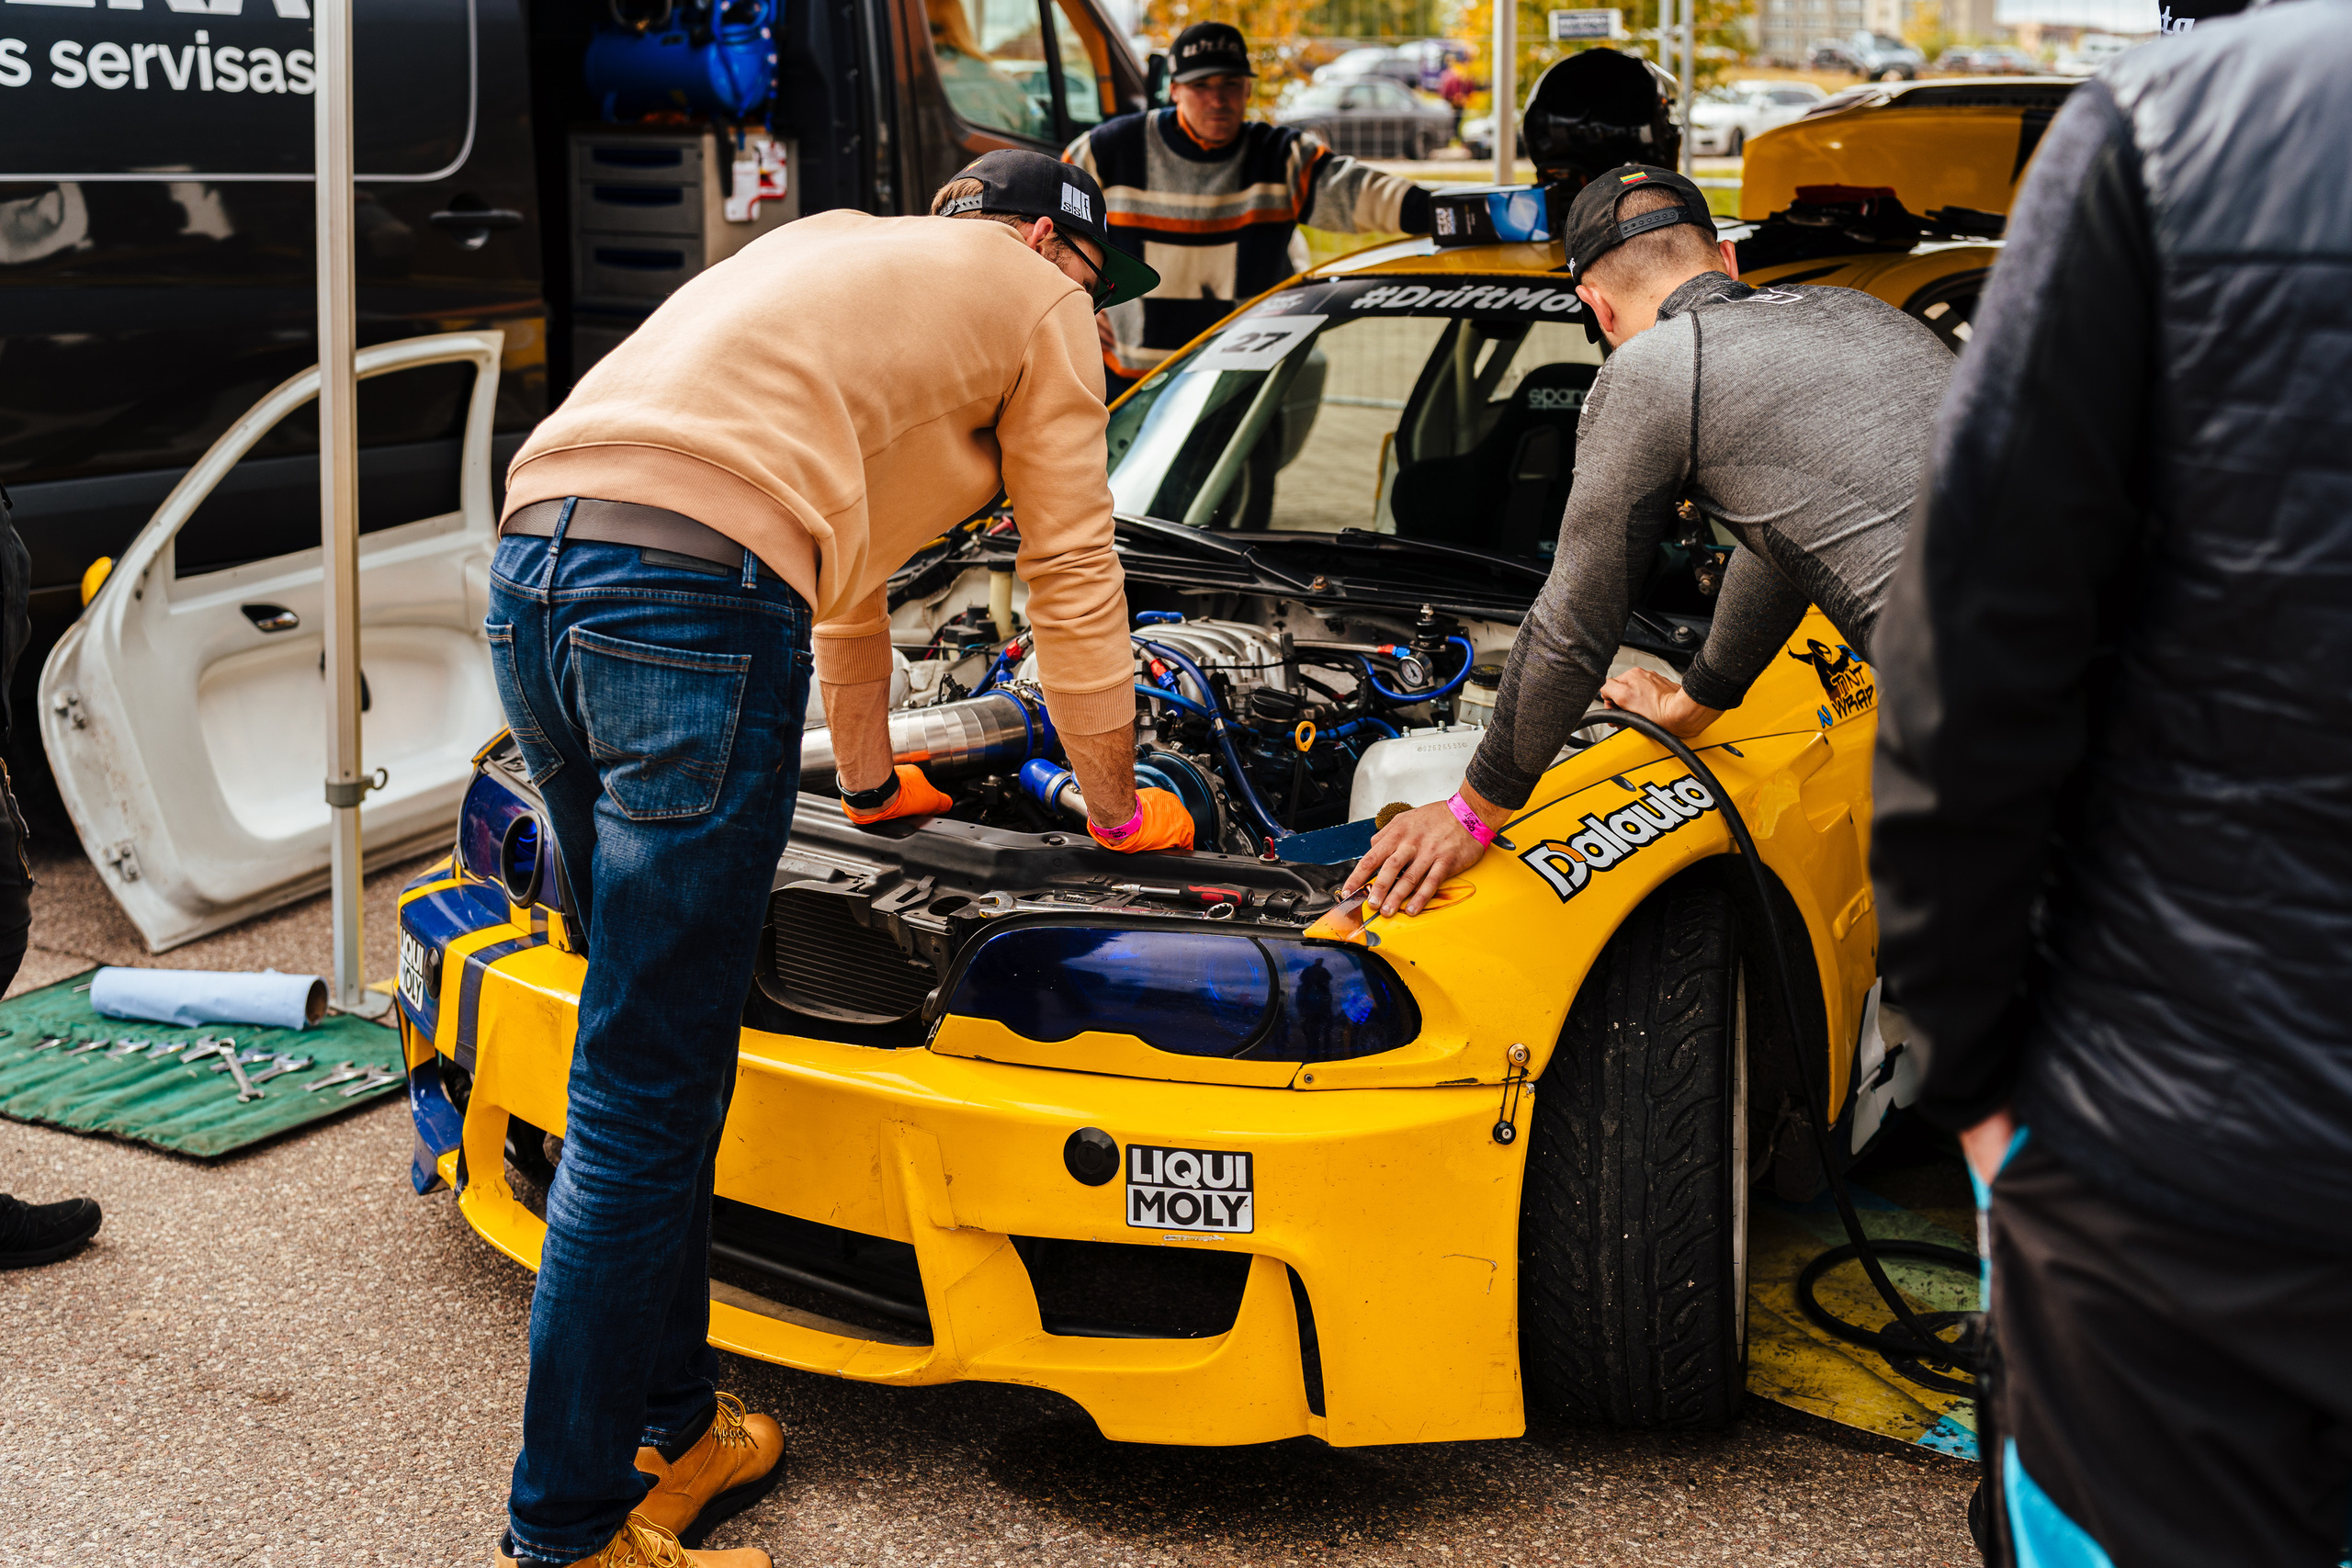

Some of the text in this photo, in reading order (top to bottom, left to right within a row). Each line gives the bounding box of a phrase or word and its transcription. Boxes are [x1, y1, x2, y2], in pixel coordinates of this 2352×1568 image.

[50, 29, 315, 94] servisas
[1220, 332, 1293, 353] 27
[1528, 389, 1587, 410] spar
[1831, 684, 1873, 719] WRAP
[1521, 775, 1716, 900] Dalauto
[1132, 1148, 1247, 1190] LIQUI
[1133, 1189, 1249, 1227] MOLY
